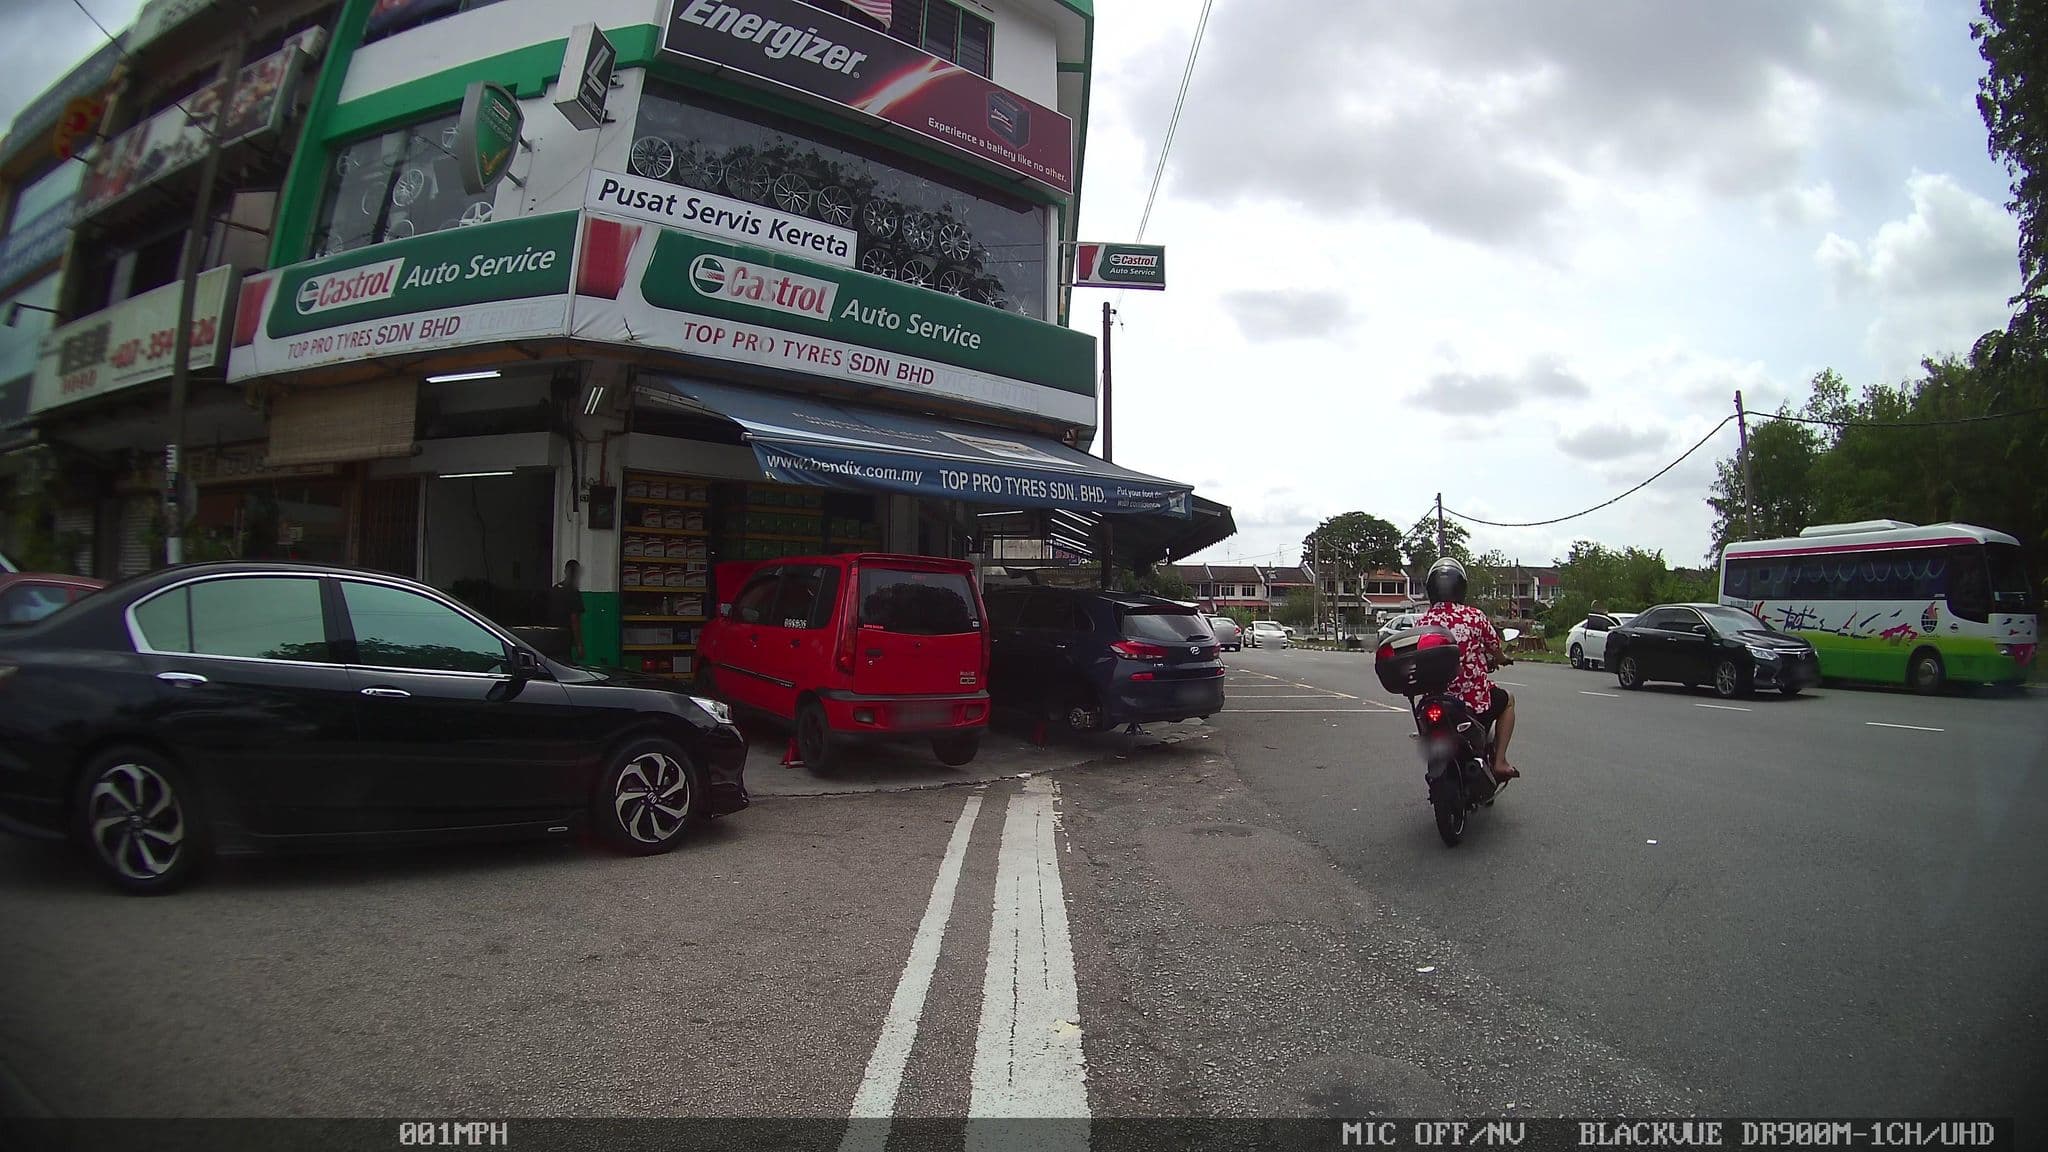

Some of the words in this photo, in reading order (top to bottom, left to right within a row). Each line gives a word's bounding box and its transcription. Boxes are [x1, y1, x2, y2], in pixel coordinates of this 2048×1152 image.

[678, 0, 868, 75] Energizer
[928, 117, 977, 144] Experience
[979, 139, 985, 147] a
[986, 140, 1016, 163] battery
[1017, 153, 1032, 168] like
[1033, 162, 1044, 172] no
[1045, 166, 1067, 183] other.
[598, 179, 679, 216] Pusat
[683, 197, 762, 236] Servis
[768, 218, 849, 258] Kereta
[319, 264, 395, 307] Castrol
[402, 263, 461, 290] Auto
[465, 246, 557, 280] Service
[1121, 256, 1155, 266] Castrol
[1129, 268, 1156, 276] Service
[287, 341, 309, 360] TOP
[311, 335, 333, 354] PRO
[336, 329, 371, 352] TYRES
[375, 321, 414, 345] SDN
[419, 315, 461, 339] BHD
[727, 265, 828, 315] Castrol
[841, 299, 901, 330] Auto
[906, 313, 981, 350] Service
[684, 321, 726, 346] TOP
[731, 330, 775, 354] PRO
[783, 339, 843, 367] TYRES
[849, 352, 891, 377] SDN
[896, 362, 935, 385] BHD
[766, 454, 923, 486] www.bendix.com.my
[939, 469, 969, 491] TOP
[972, 473, 1002, 494] PRO
[1004, 476, 1047, 498] TYRES
[1050, 481, 1078, 501] SDN.
[1080, 484, 1107, 504] BHD.
[1117, 486, 1128, 495] Put
[1128, 489, 1141, 498] your
